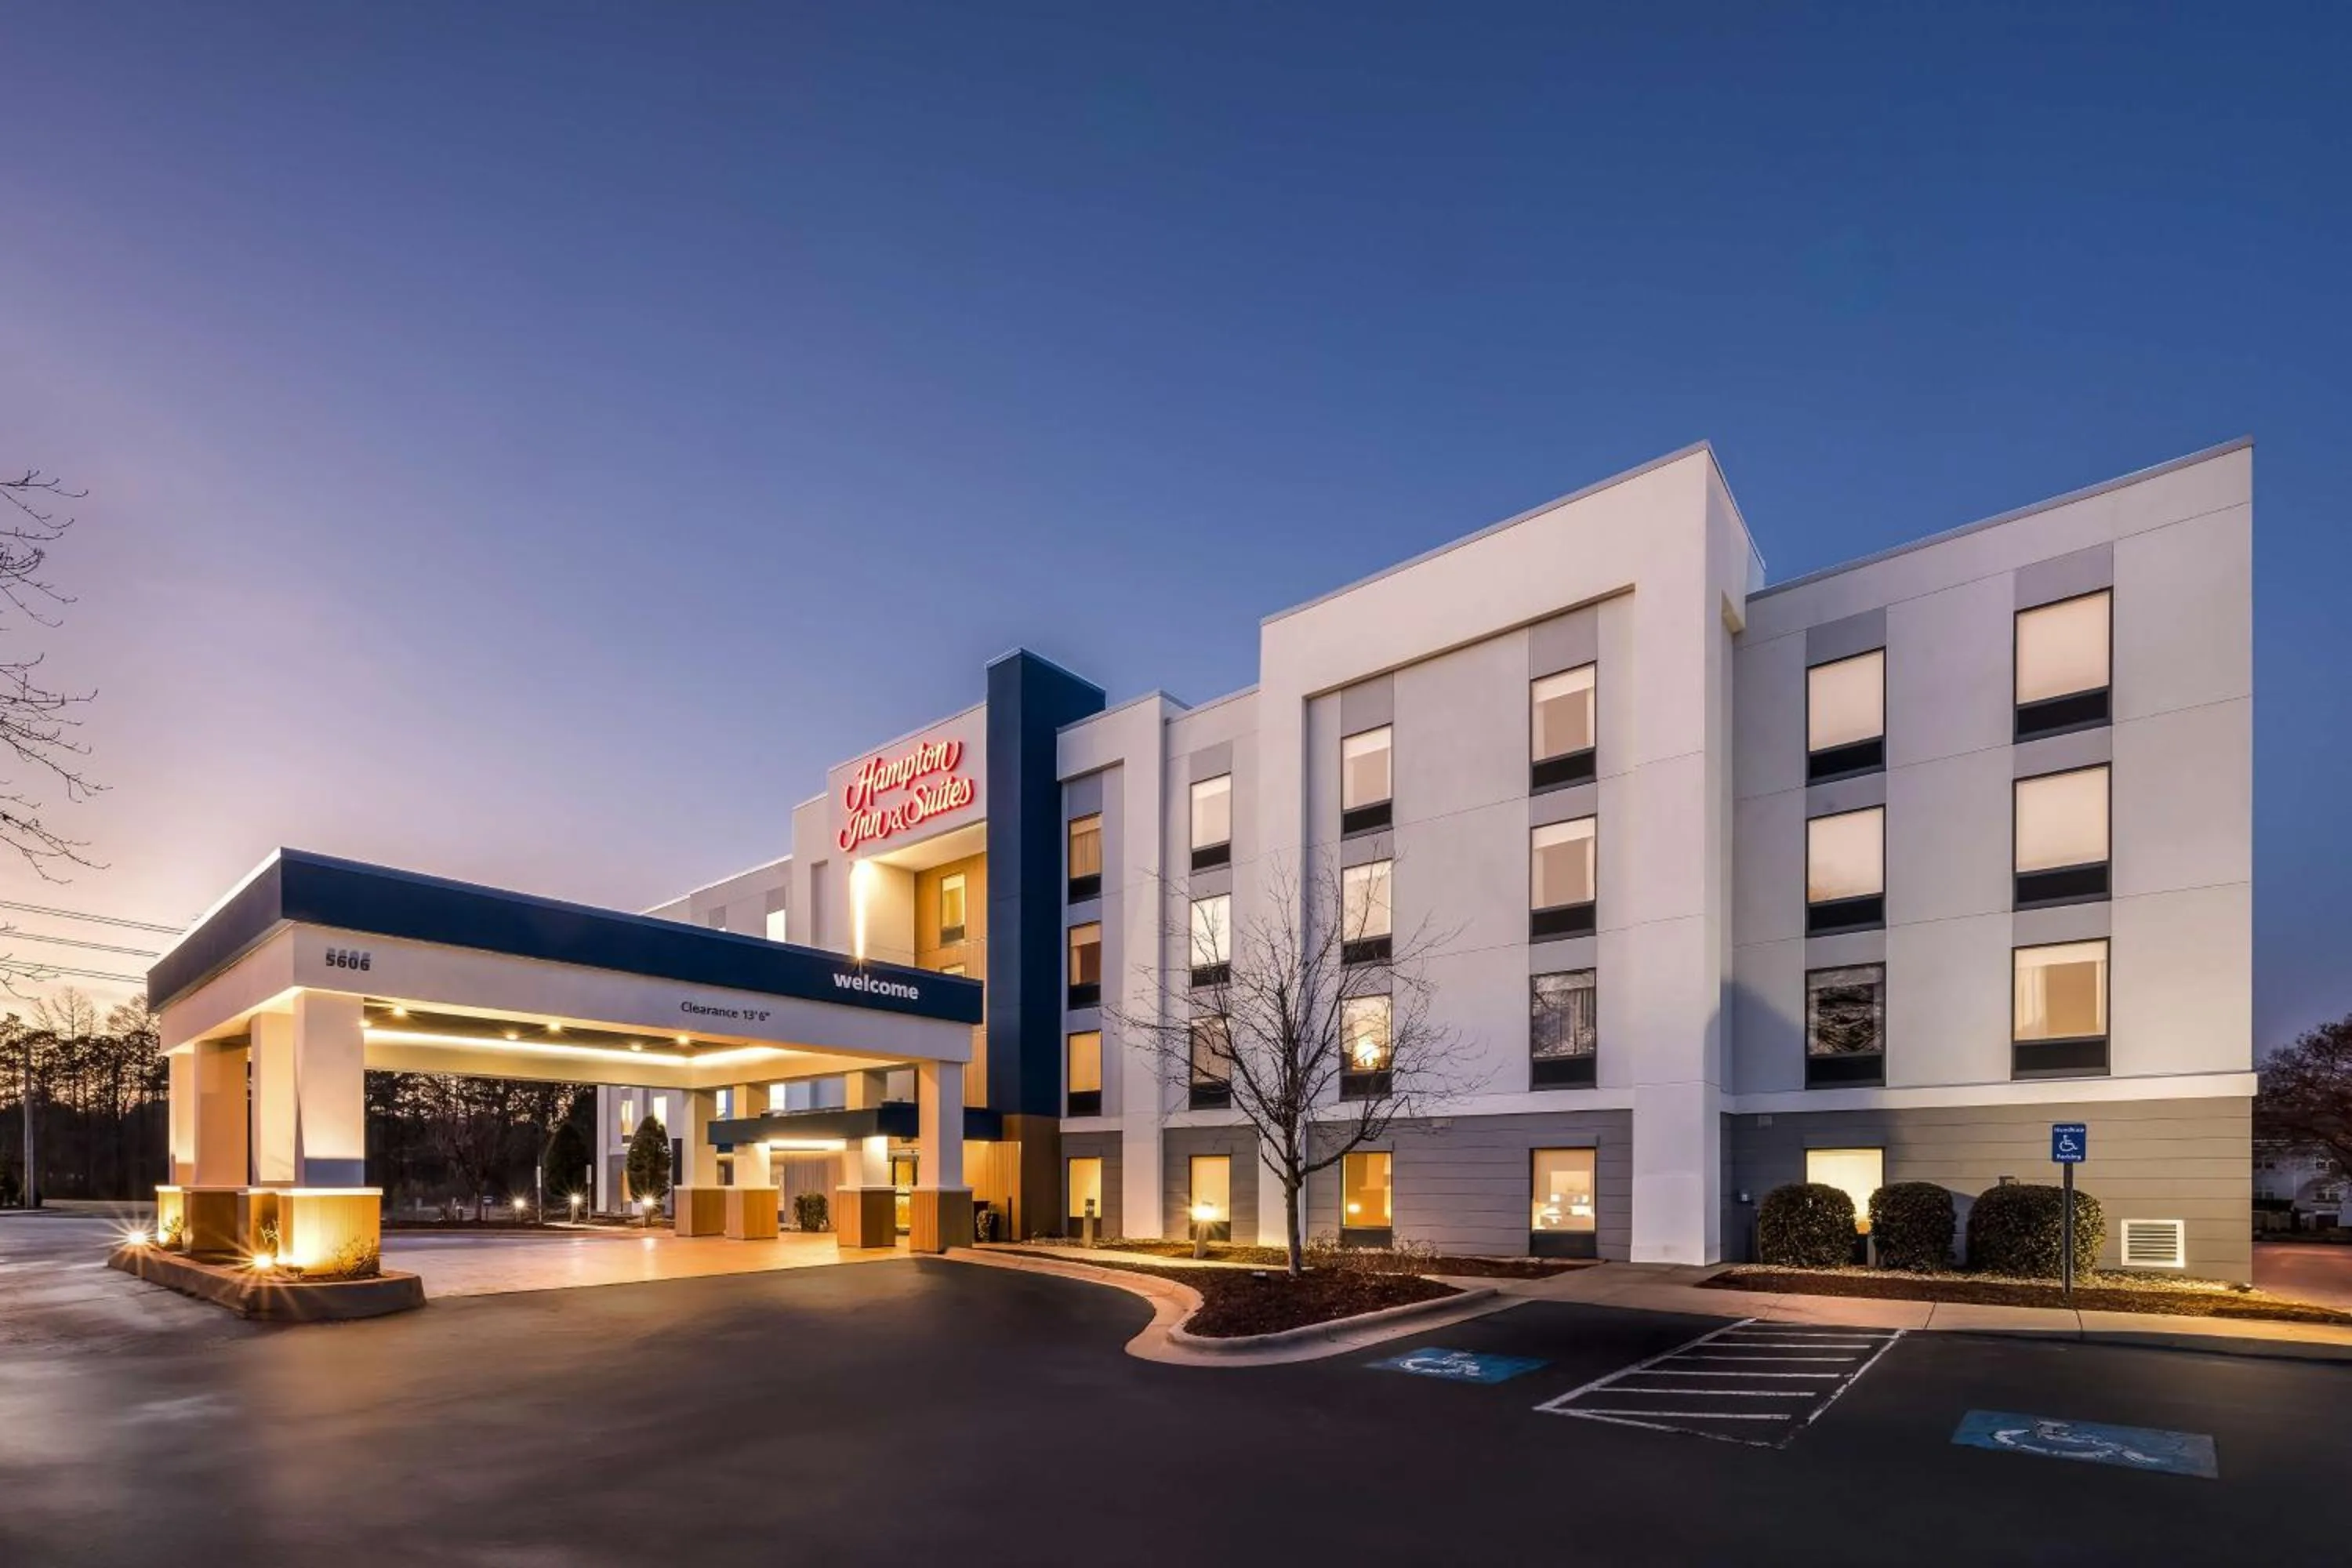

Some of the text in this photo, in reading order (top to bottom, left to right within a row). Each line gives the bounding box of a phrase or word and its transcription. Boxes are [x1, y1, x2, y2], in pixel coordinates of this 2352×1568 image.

[844, 740, 962, 812] Hampton
[837, 775, 974, 852] Inn & Suites
[325, 953, 371, 971] 5606
[833, 972, 919, 1000] welcome
[681, 1000, 739, 1019] Clearance
